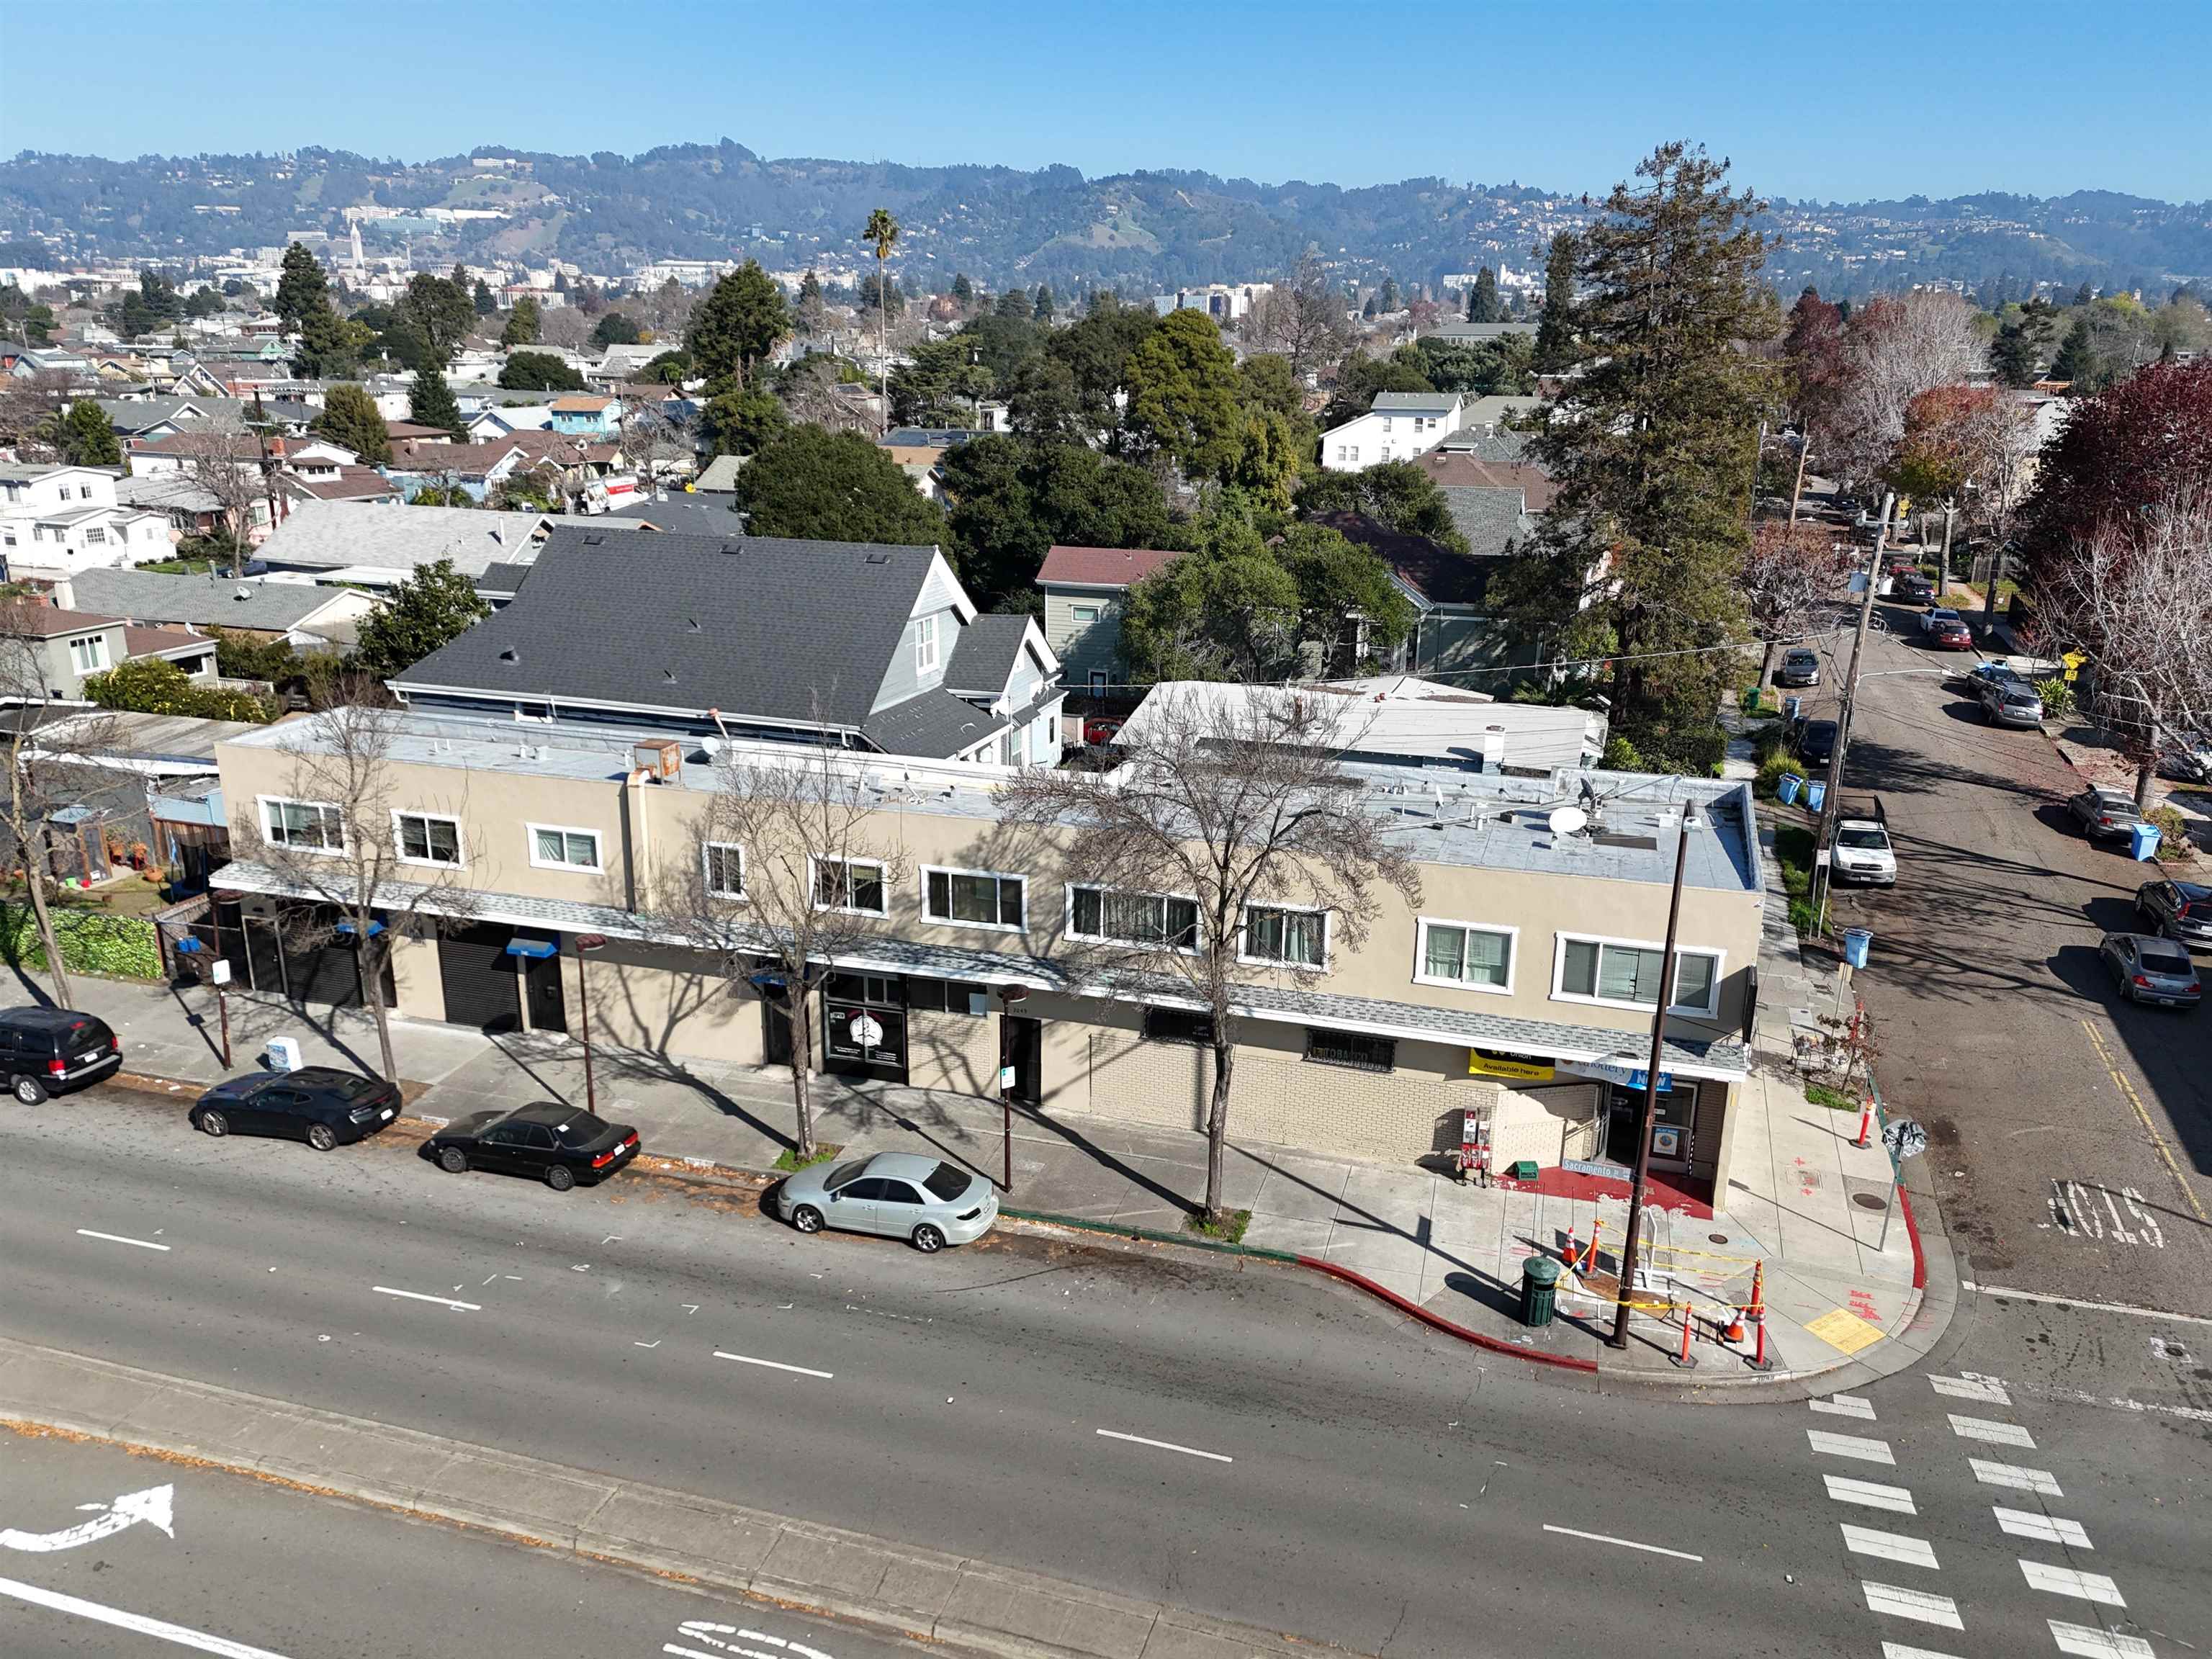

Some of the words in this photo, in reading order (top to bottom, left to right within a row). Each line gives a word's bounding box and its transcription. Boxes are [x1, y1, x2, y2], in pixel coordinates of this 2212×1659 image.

[1483, 1063, 1519, 1073] Available
[1636, 1074, 1666, 1087] NW
[1564, 1160, 1611, 1175] Sacramento
